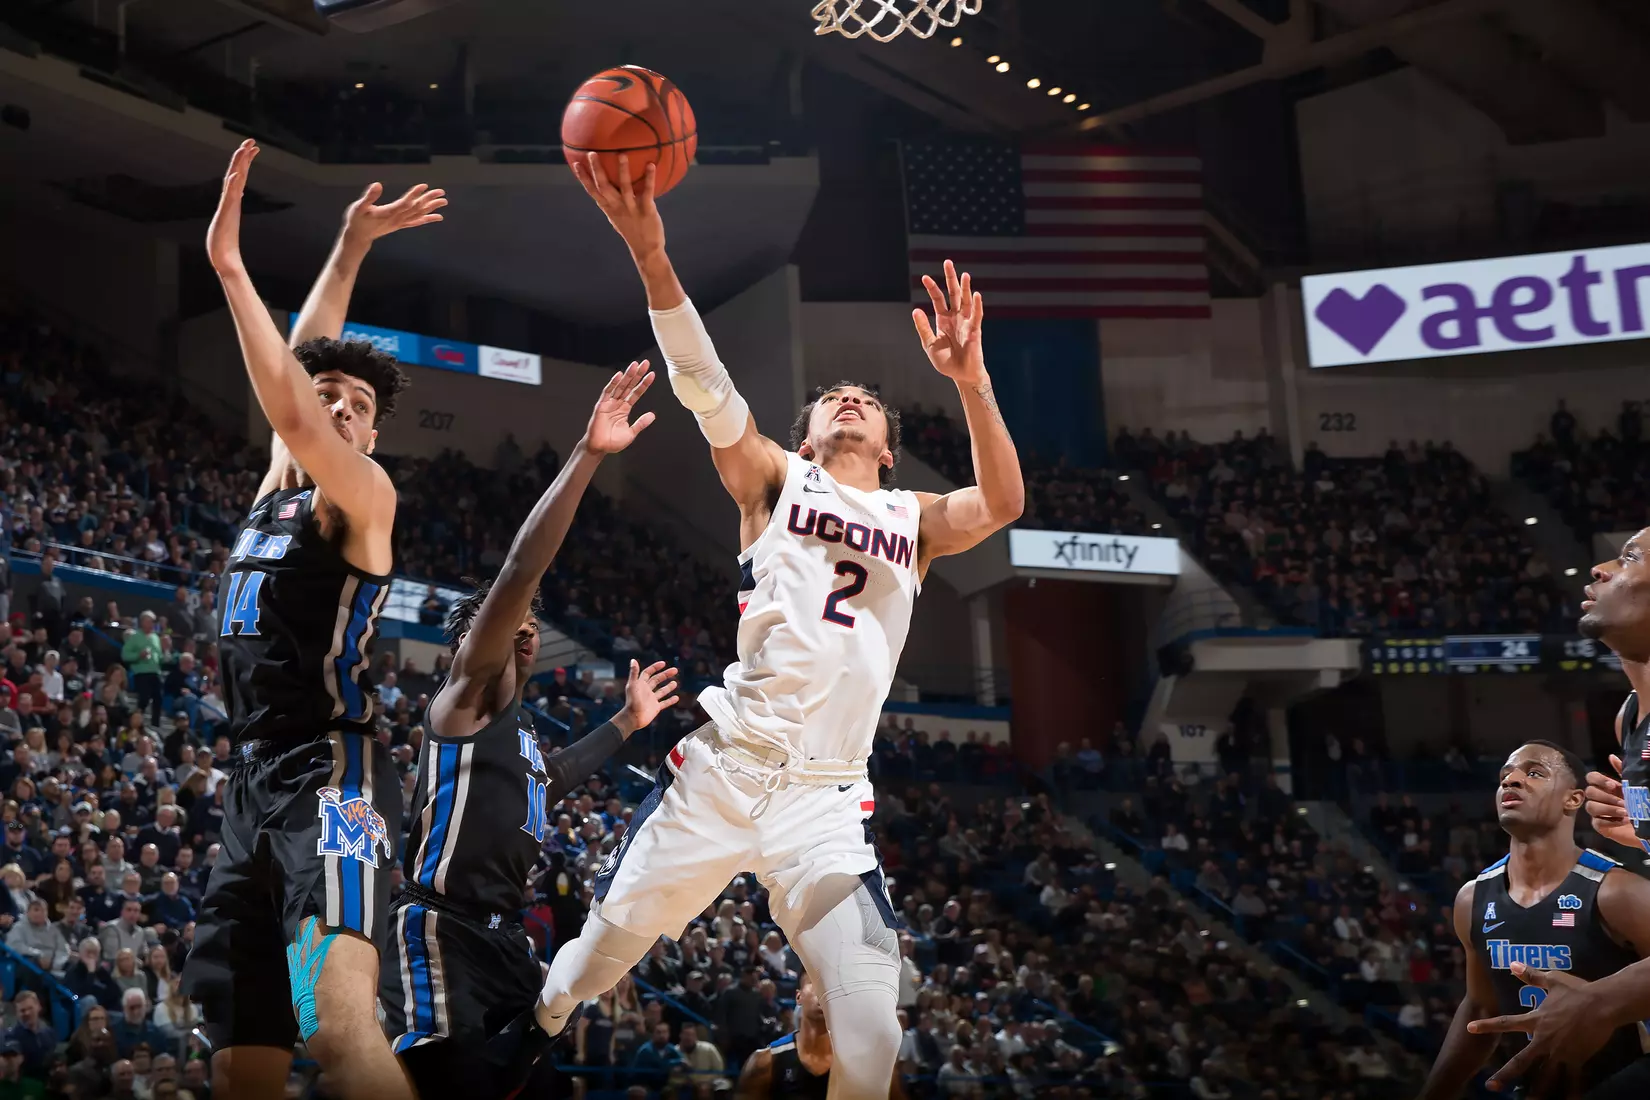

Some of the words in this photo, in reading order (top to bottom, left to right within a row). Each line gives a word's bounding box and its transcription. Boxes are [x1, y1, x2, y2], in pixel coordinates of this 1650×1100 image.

[419, 410, 455, 431] 207
[1320, 413, 1356, 432] 232
[787, 504, 914, 569] UCONN
[1053, 535, 1139, 569] xfinity
[220, 571, 266, 636] 14
[822, 560, 868, 628] 2
[520, 773, 547, 843] 10
[1558, 894, 1582, 909] 100
[1486, 939, 1572, 970] Tigers
